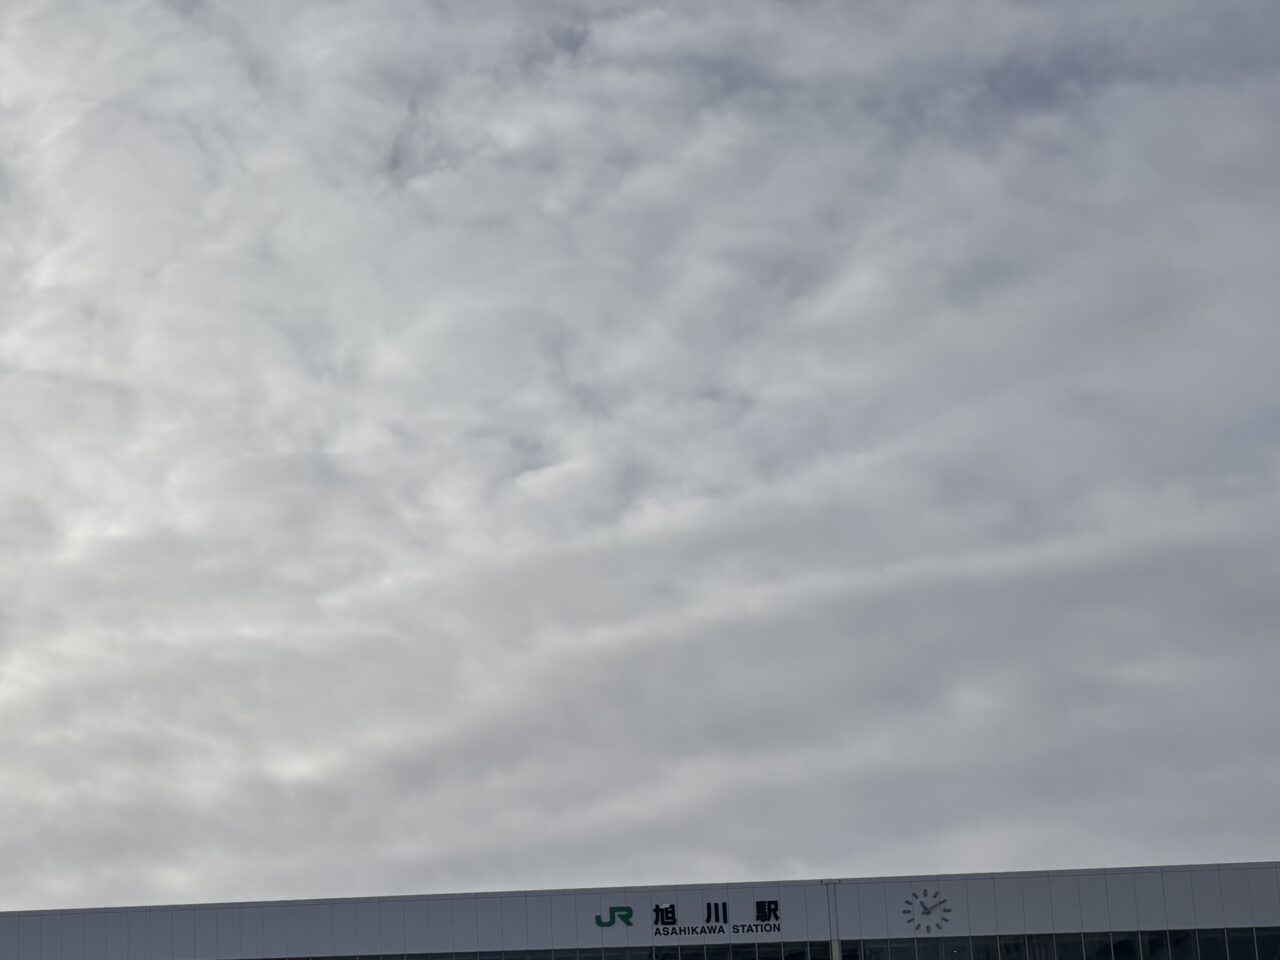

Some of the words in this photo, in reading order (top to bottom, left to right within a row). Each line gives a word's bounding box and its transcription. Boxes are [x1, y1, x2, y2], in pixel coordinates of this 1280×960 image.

[595, 906, 634, 927] JR
[653, 900, 780, 926] 旭川駅
[654, 924, 726, 937] ASAHIKAWA
[732, 922, 781, 934] STATION
